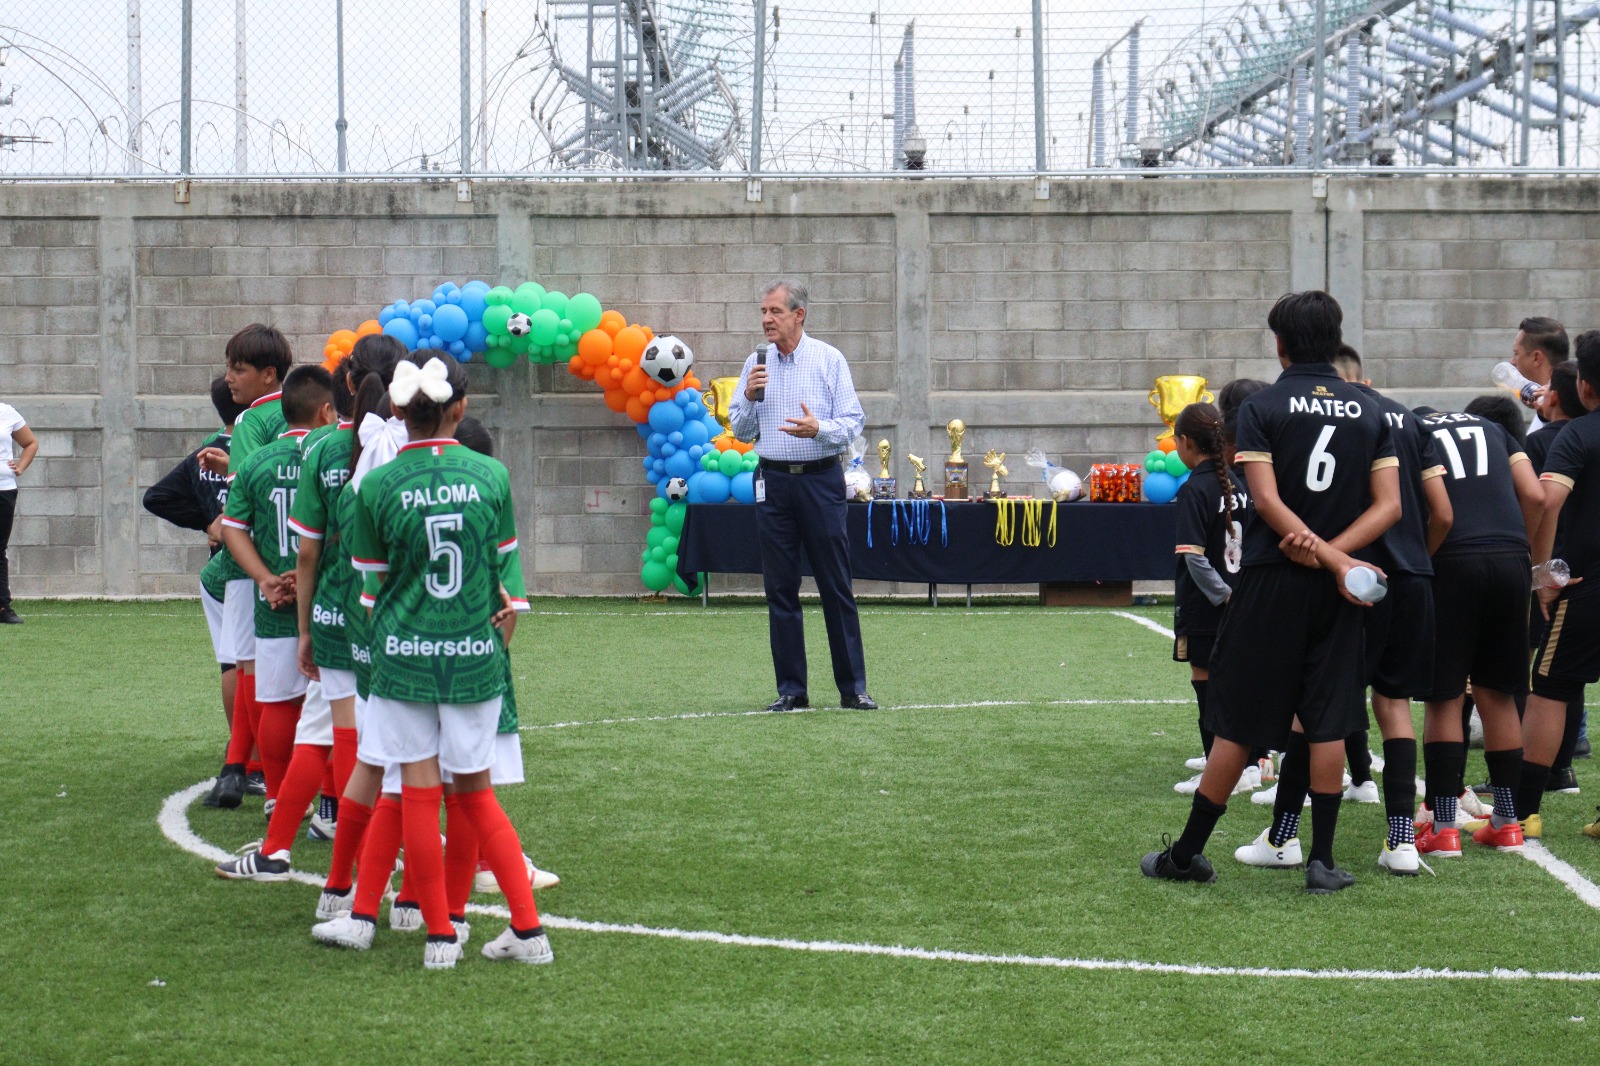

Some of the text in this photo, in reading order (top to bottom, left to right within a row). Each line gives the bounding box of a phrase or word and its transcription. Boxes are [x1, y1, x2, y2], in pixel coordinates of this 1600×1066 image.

[1289, 396, 1362, 418] MATEO
[1306, 424, 1337, 492] 6
[1433, 426, 1489, 480] 17
[401, 483, 481, 510] PALOMA
[425, 513, 463, 599] 5
